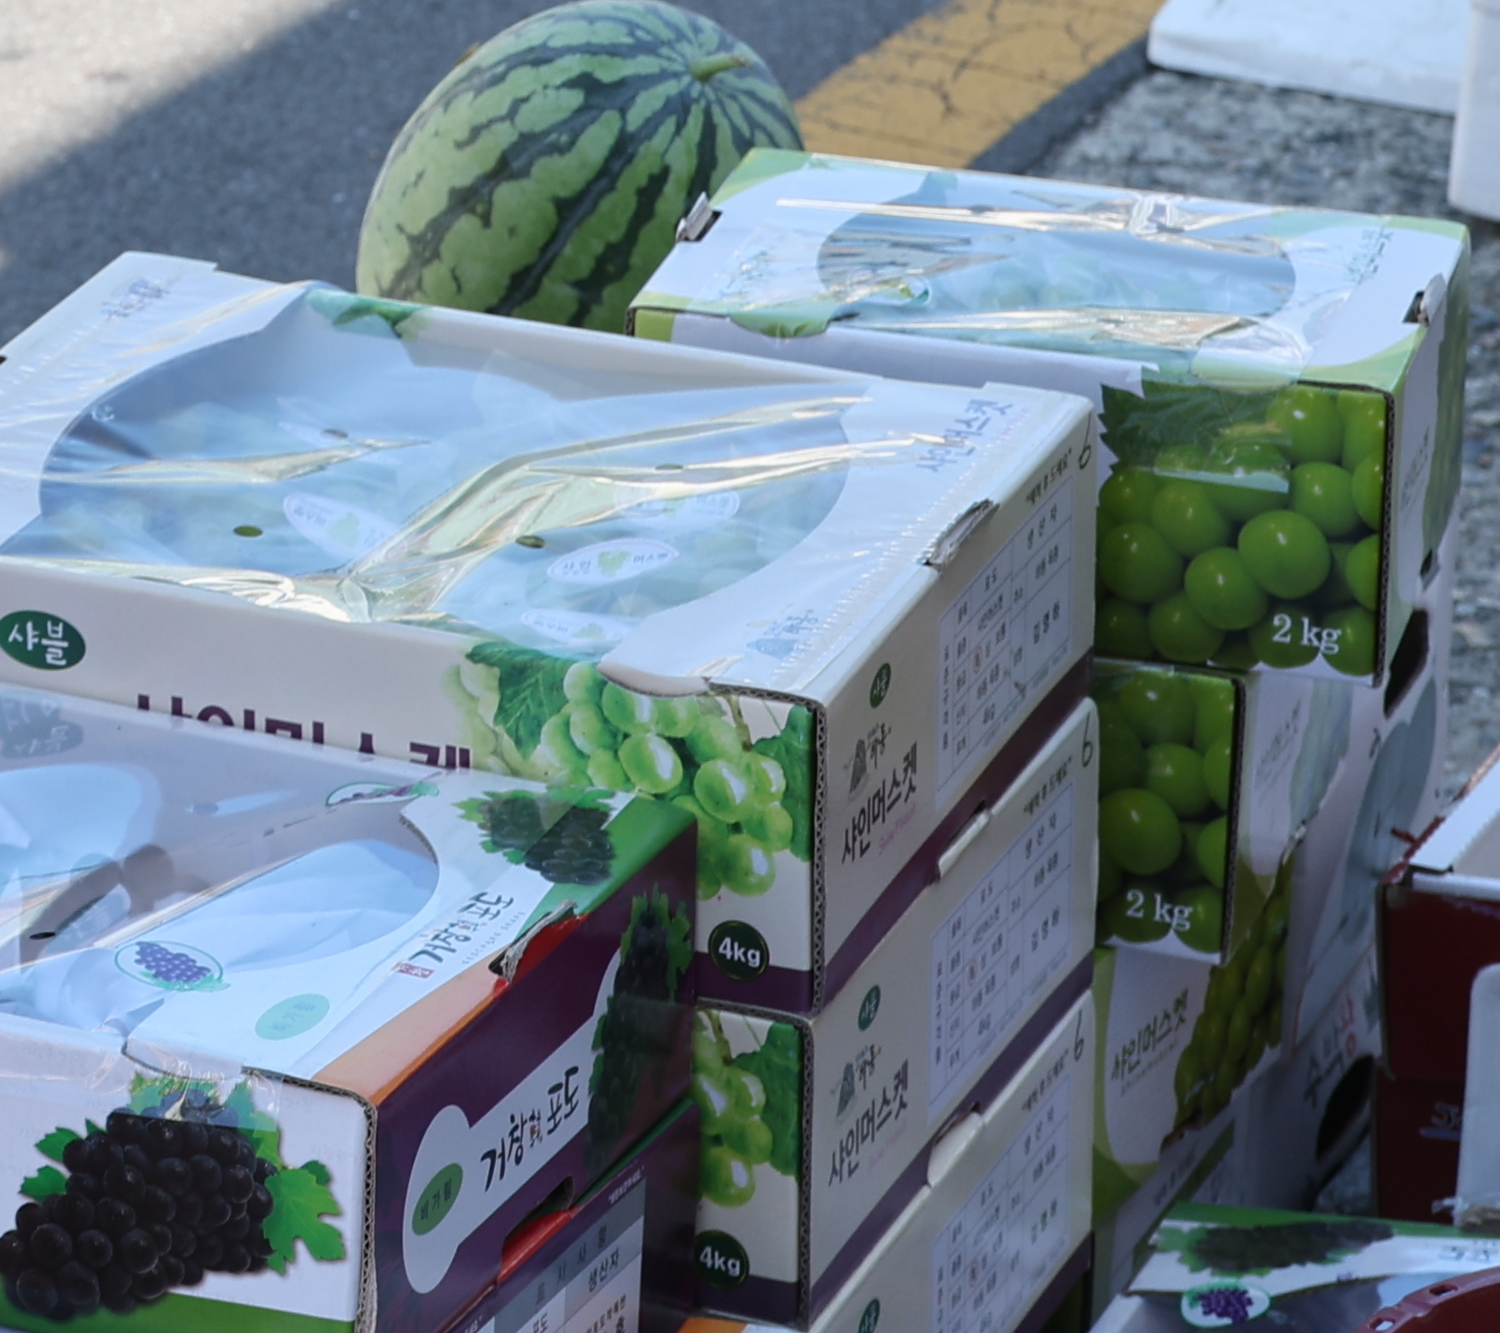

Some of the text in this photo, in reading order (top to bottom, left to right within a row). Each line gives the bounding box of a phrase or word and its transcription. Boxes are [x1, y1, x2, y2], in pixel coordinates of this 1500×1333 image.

[7, 620, 69, 666] 샤블
[1273, 614, 1342, 654] 2 kg
[841, 741, 918, 865] 샤인머스켓
[1126, 889, 1194, 933] 2 kg
[718, 937, 761, 968] 4kg
[1111, 987, 1189, 1081] 샤인머스켓
[547, 1066, 580, 1135] 포도
[828, 1059, 909, 1188] 샤인머스켓
[588, 1247, 619, 1292] 생산자
[699, 1246, 741, 1277] 4kg
